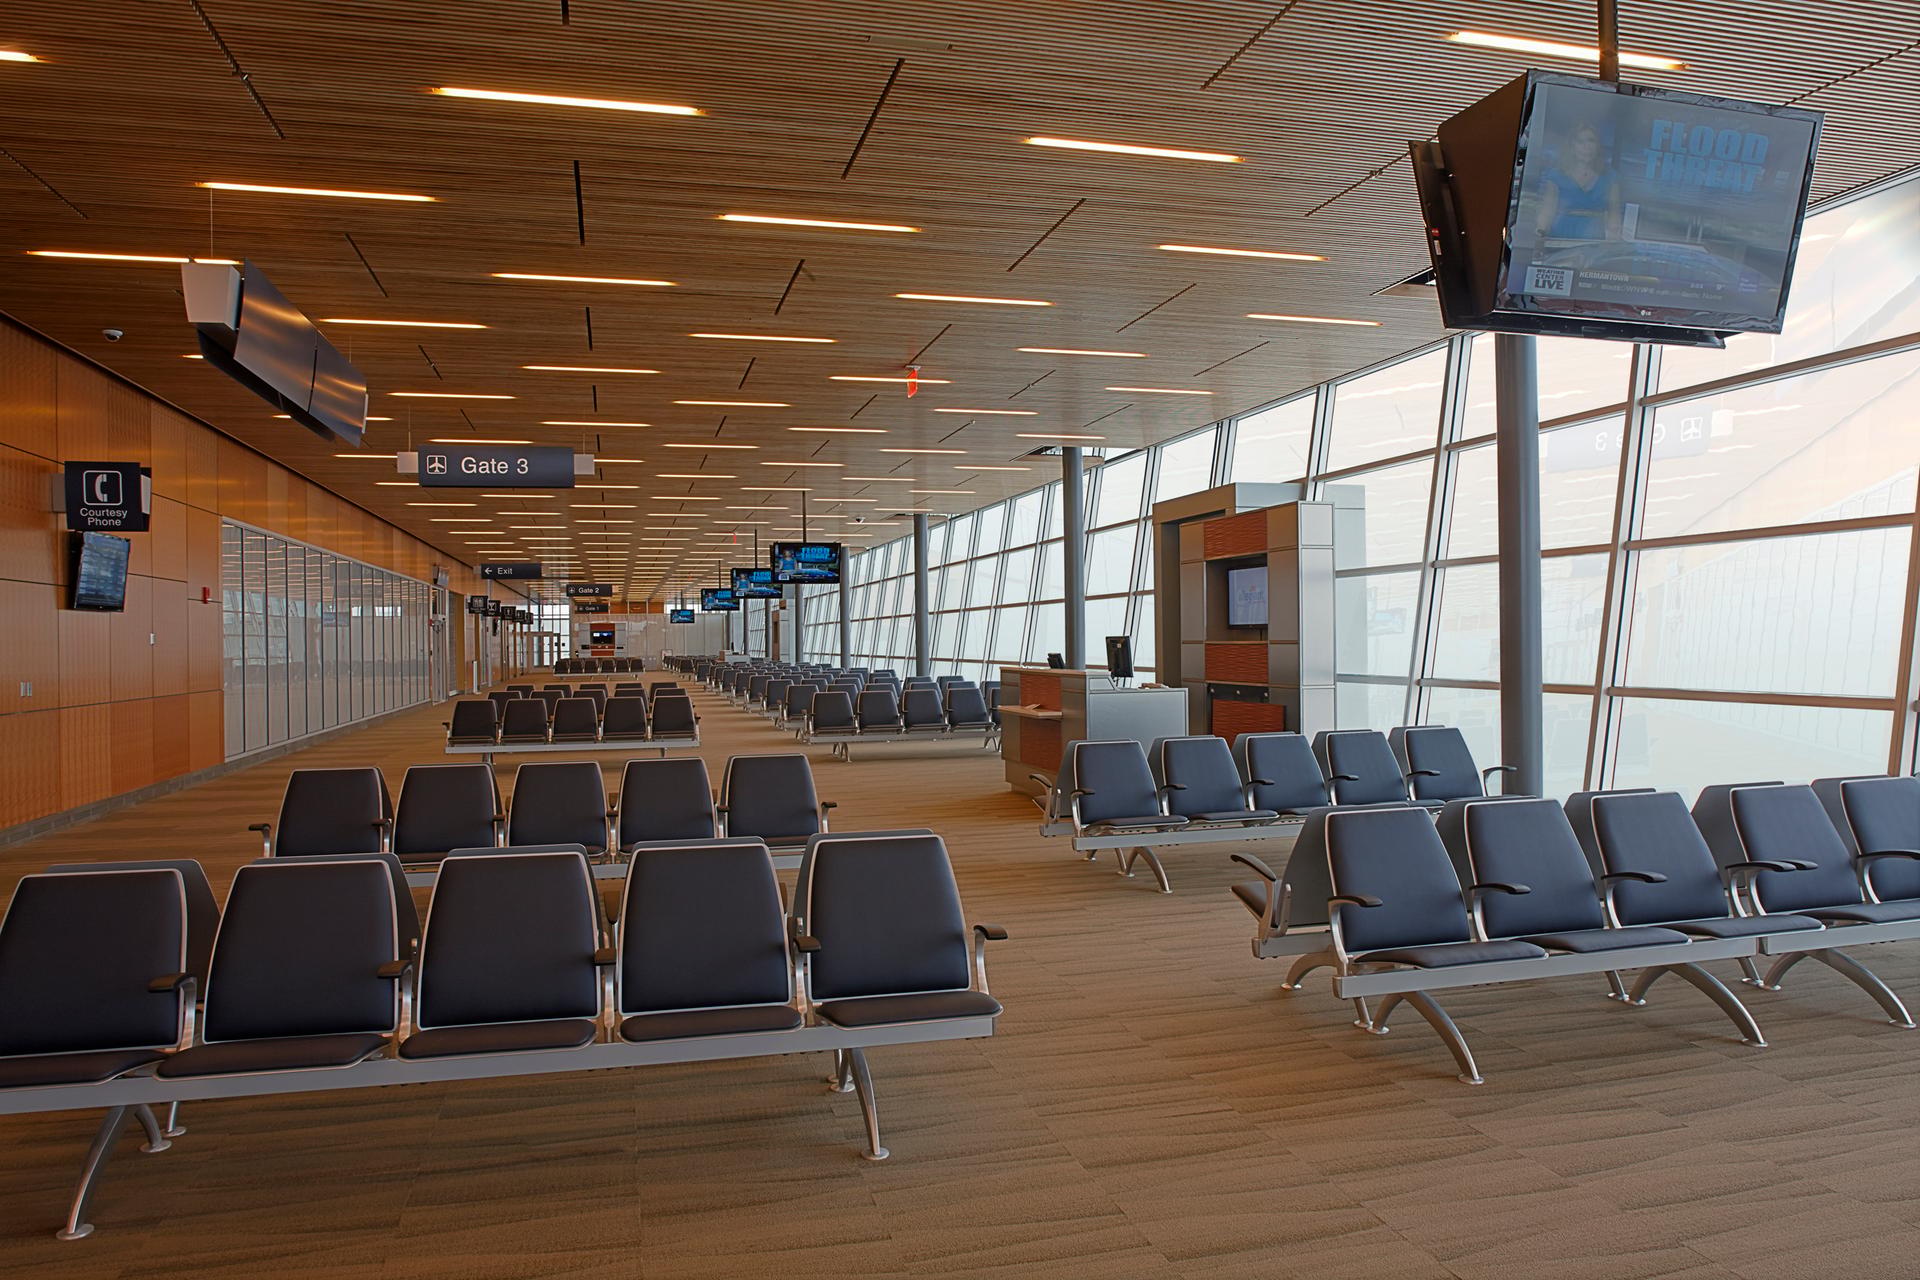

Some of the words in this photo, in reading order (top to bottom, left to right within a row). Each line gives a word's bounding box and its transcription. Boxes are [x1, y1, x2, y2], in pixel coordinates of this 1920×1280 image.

[1650, 119, 1769, 163] FLOOD
[1644, 149, 1766, 193] THREAT
[1535, 279, 1564, 290] LIVE
[461, 457, 509, 474] Gate
[516, 458, 529, 474] 3
[79, 507, 128, 519] Courtesy
[87, 516, 122, 526] Phone
[497, 567, 513, 575] Exit
